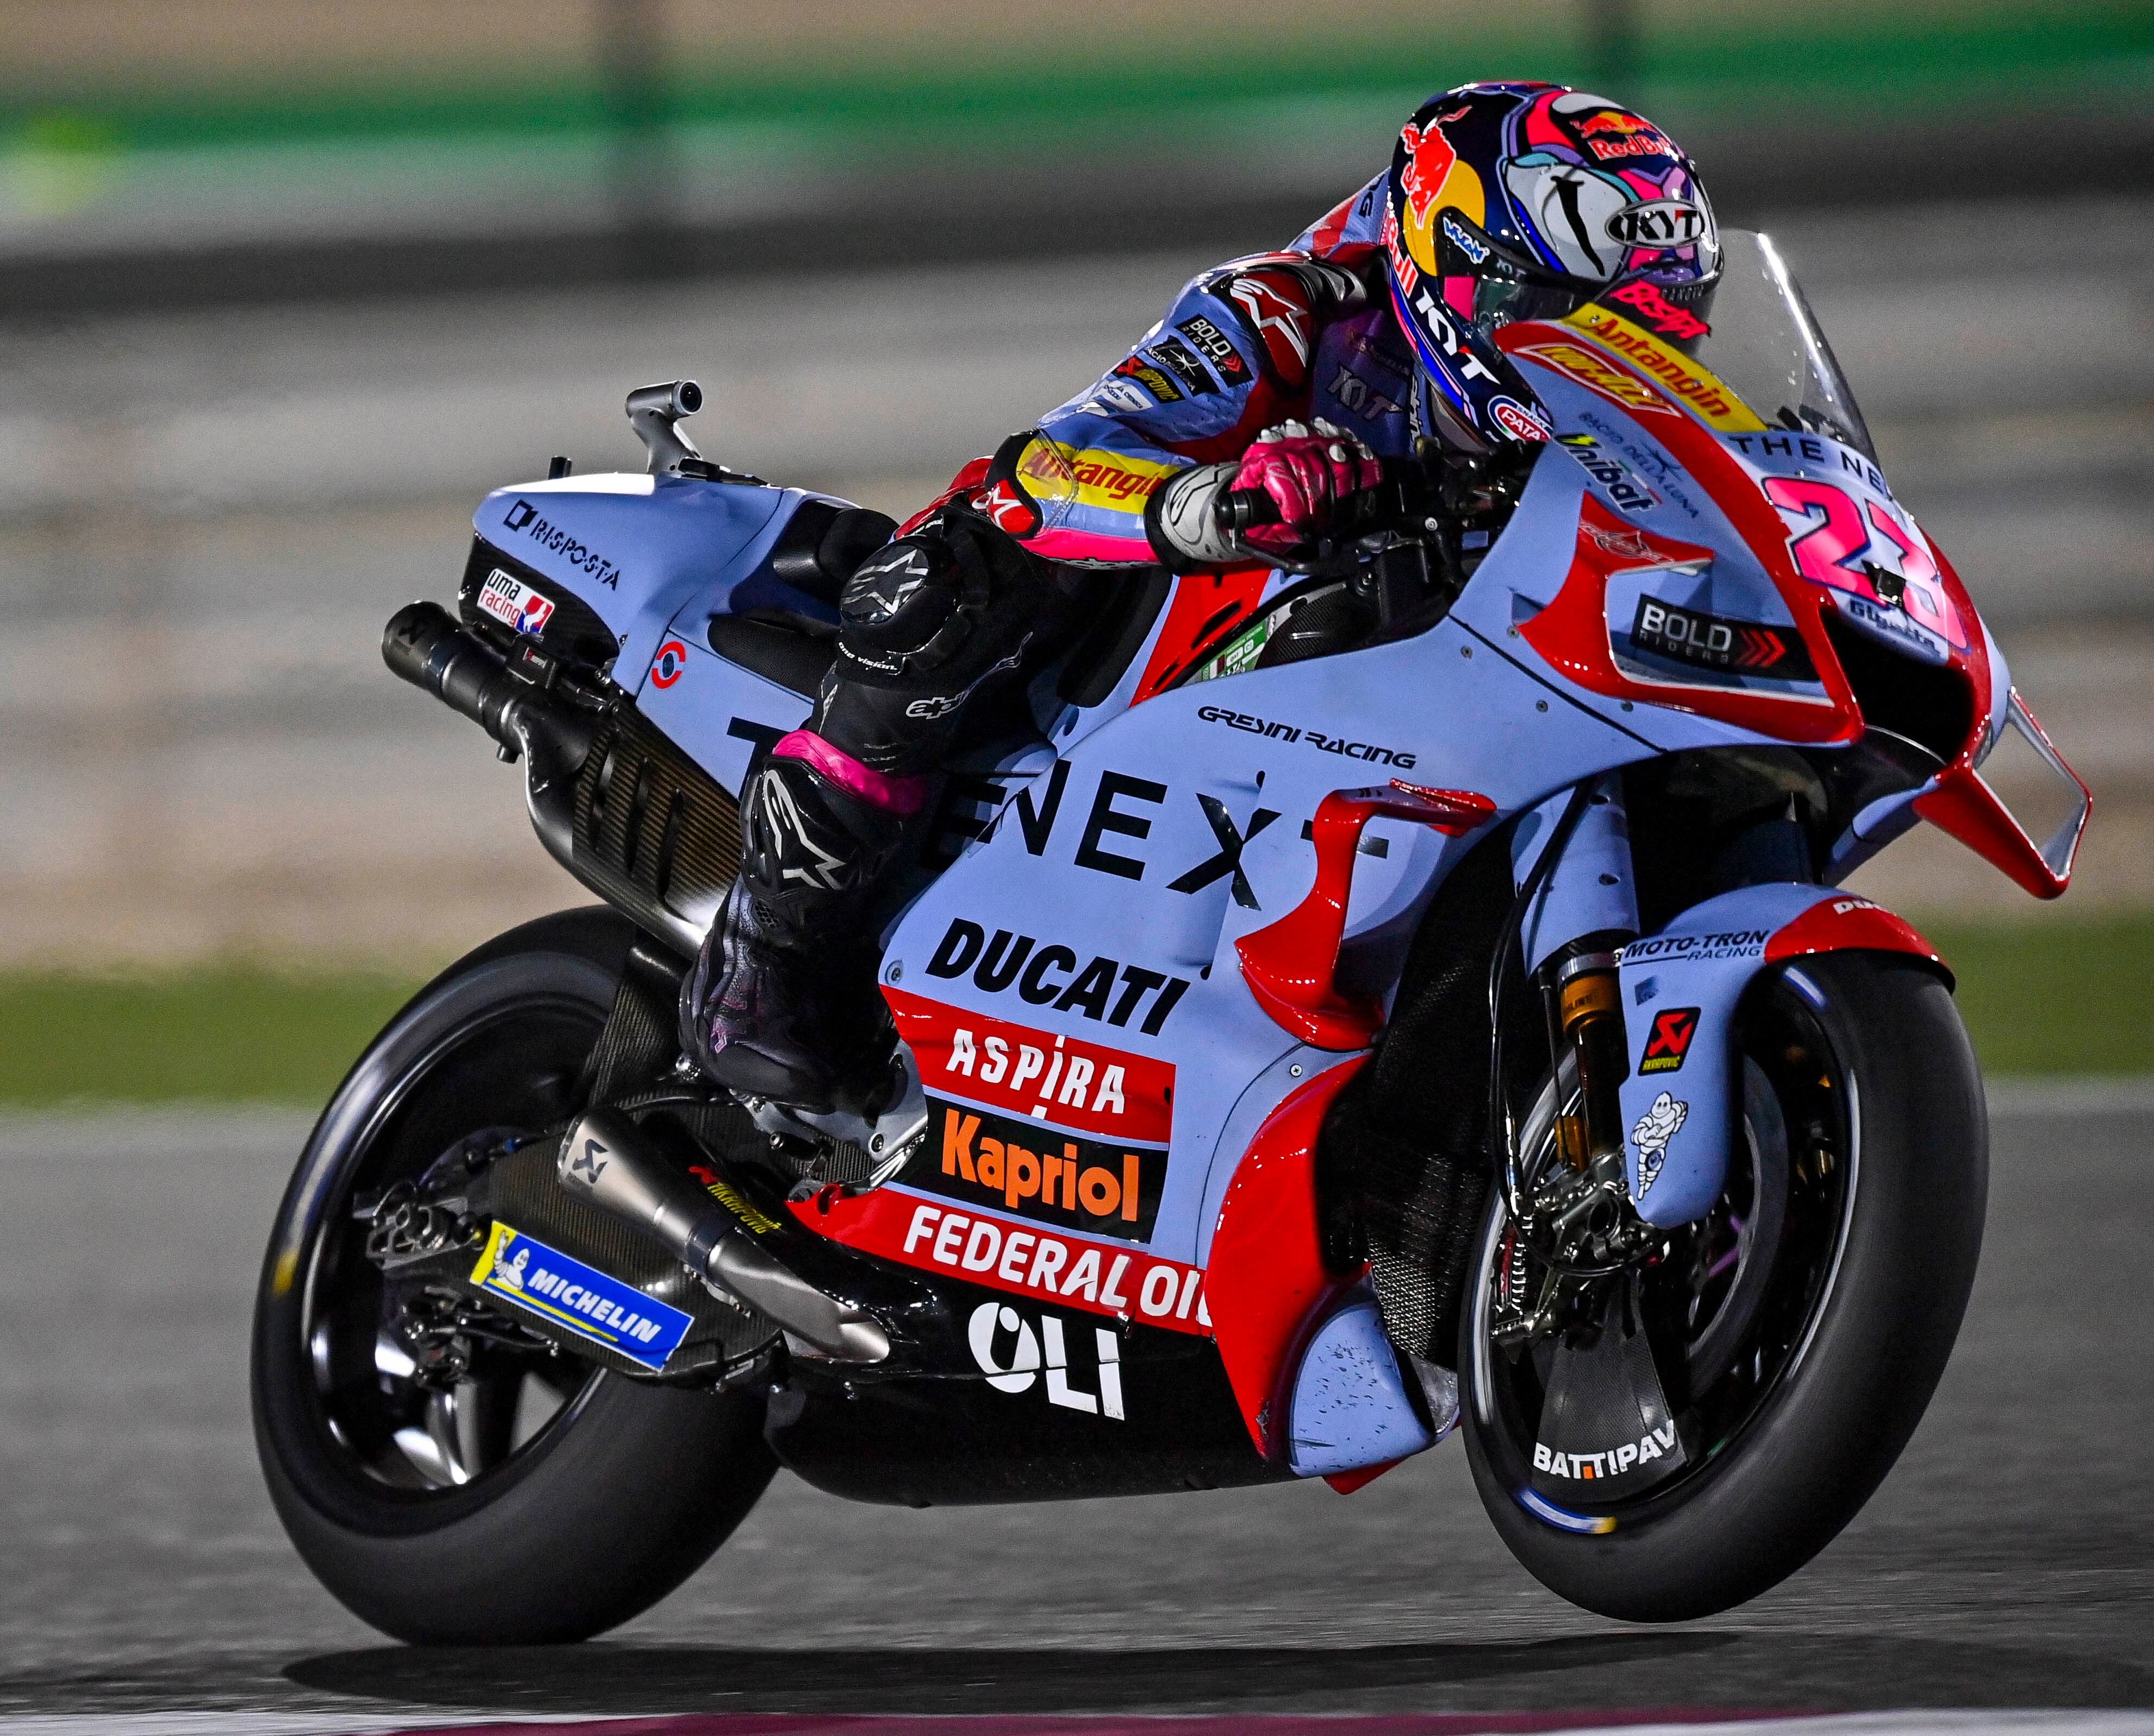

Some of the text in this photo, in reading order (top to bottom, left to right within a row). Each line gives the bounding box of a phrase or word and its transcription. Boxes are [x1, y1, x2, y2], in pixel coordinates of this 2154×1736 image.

[1587, 134, 1678, 162] Red Bu
[1622, 210, 1697, 240] KYT
[1181, 326, 1226, 372] RIDERS
[1189, 319, 1232, 356] BOLD
[1415, 286, 1502, 385] KYT
[1328, 364, 1402, 420] KYT
[1594, 318, 1731, 417] Antangin
[1501, 409, 1541, 441] PATA
[1555, 433, 1654, 511] Unibat
[1728, 436, 1892, 500] THE NE
[487, 571, 521, 601] uma
[1761, 476, 1973, 655] 23
[480, 589, 521, 626] racing
[1642, 604, 1732, 652] BOLD
[839, 642, 856, 659] one
[1639, 628, 1729, 664] RIDERS
[1198, 705, 1416, 770] GRESINI RACING
[1624, 929, 1770, 959] MOTO-TRON
[1687, 945, 1763, 961] RACING
[925, 917, 1191, 1037] DUCATI
[941, 1109, 1140, 1222] Kapriol
[903, 1205, 1130, 1309] FEDERAL
[527, 1268, 662, 1344] MICHELIN
[1533, 1419, 1676, 1479] BATTIPAV
